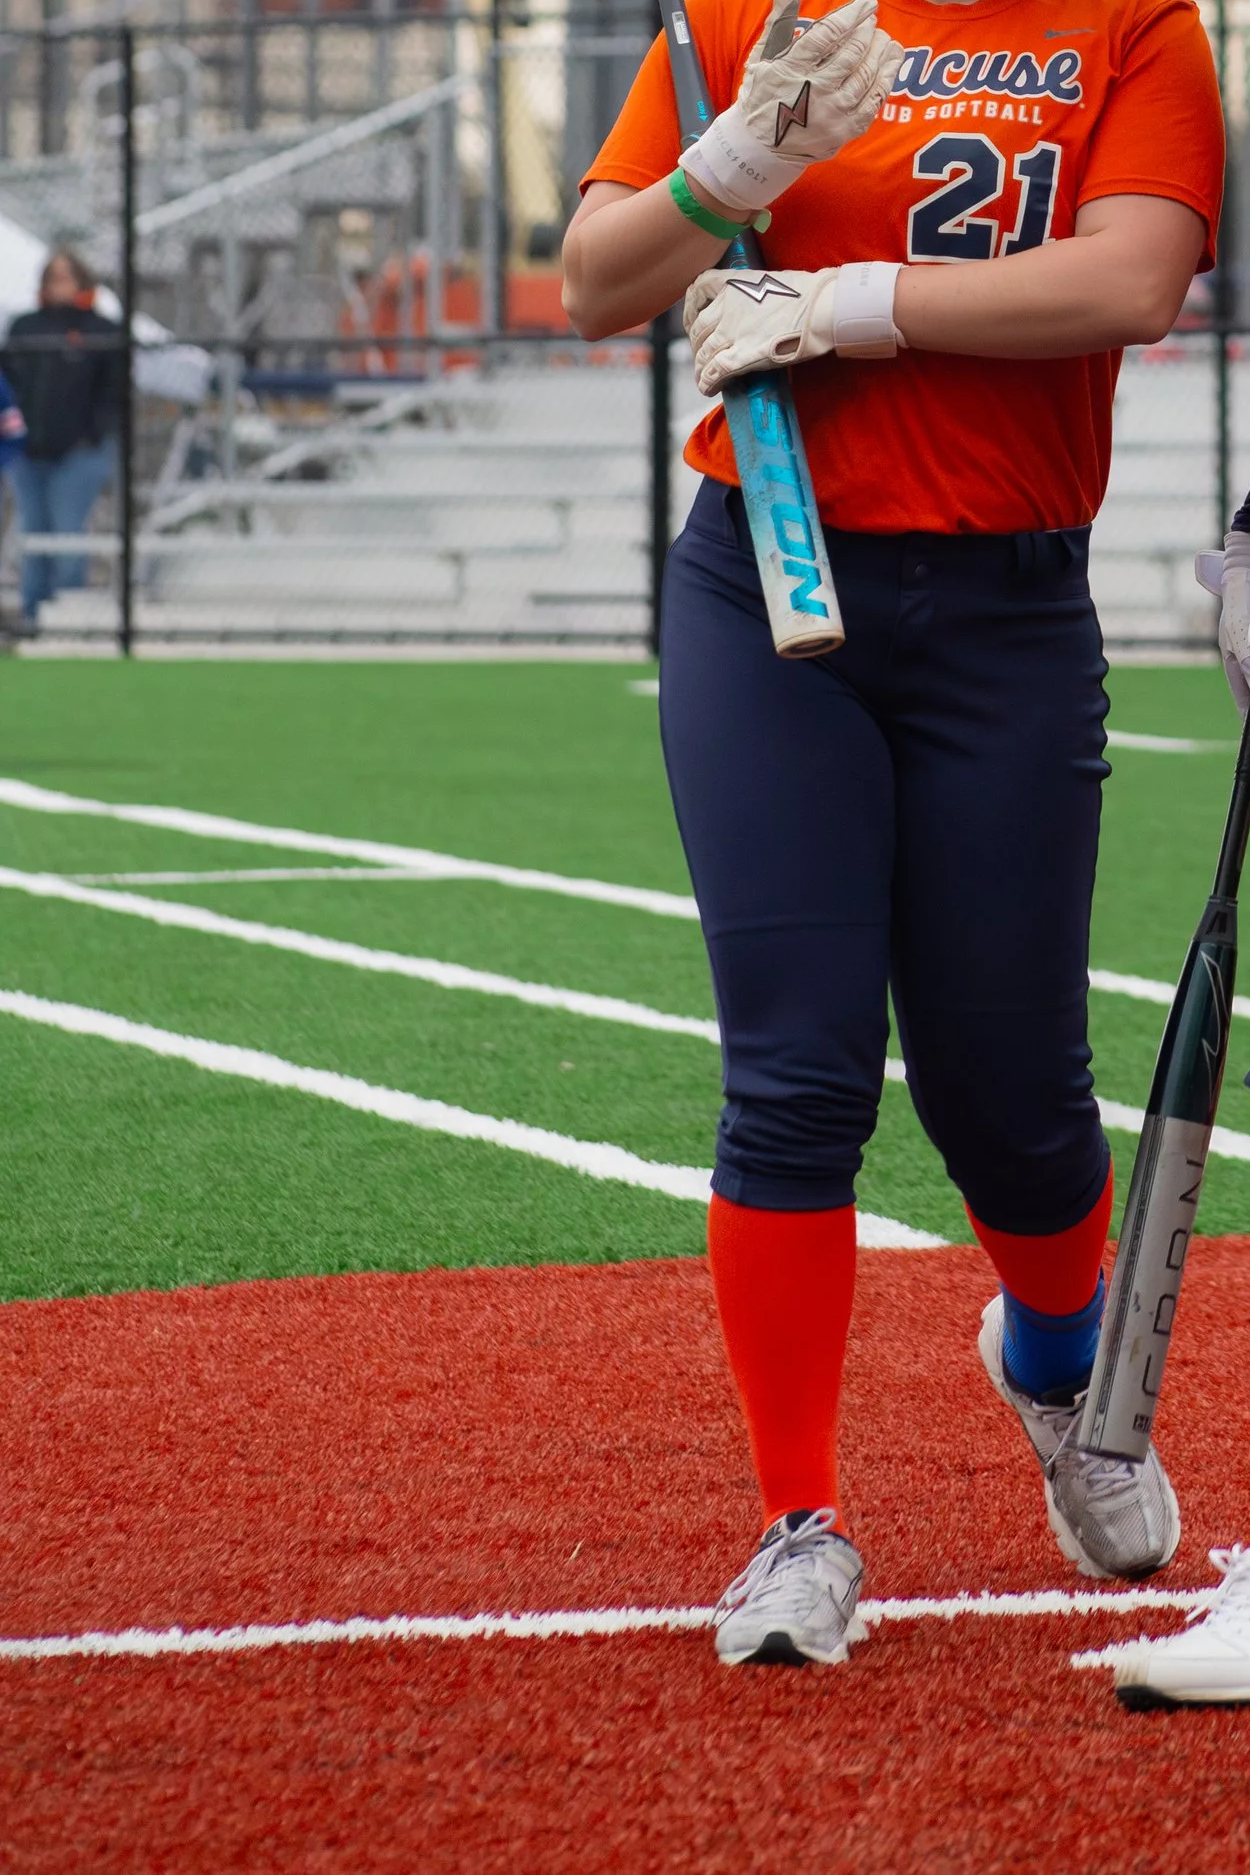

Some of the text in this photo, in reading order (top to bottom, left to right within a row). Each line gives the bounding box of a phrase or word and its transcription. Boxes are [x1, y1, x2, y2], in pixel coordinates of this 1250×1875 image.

[890, 46, 1083, 104] acuse
[874, 100, 1043, 124] UB SOFTBALL
[738, 161, 768, 185] BOLT
[907, 132, 1062, 264] 21
[748, 382, 829, 619] STON
